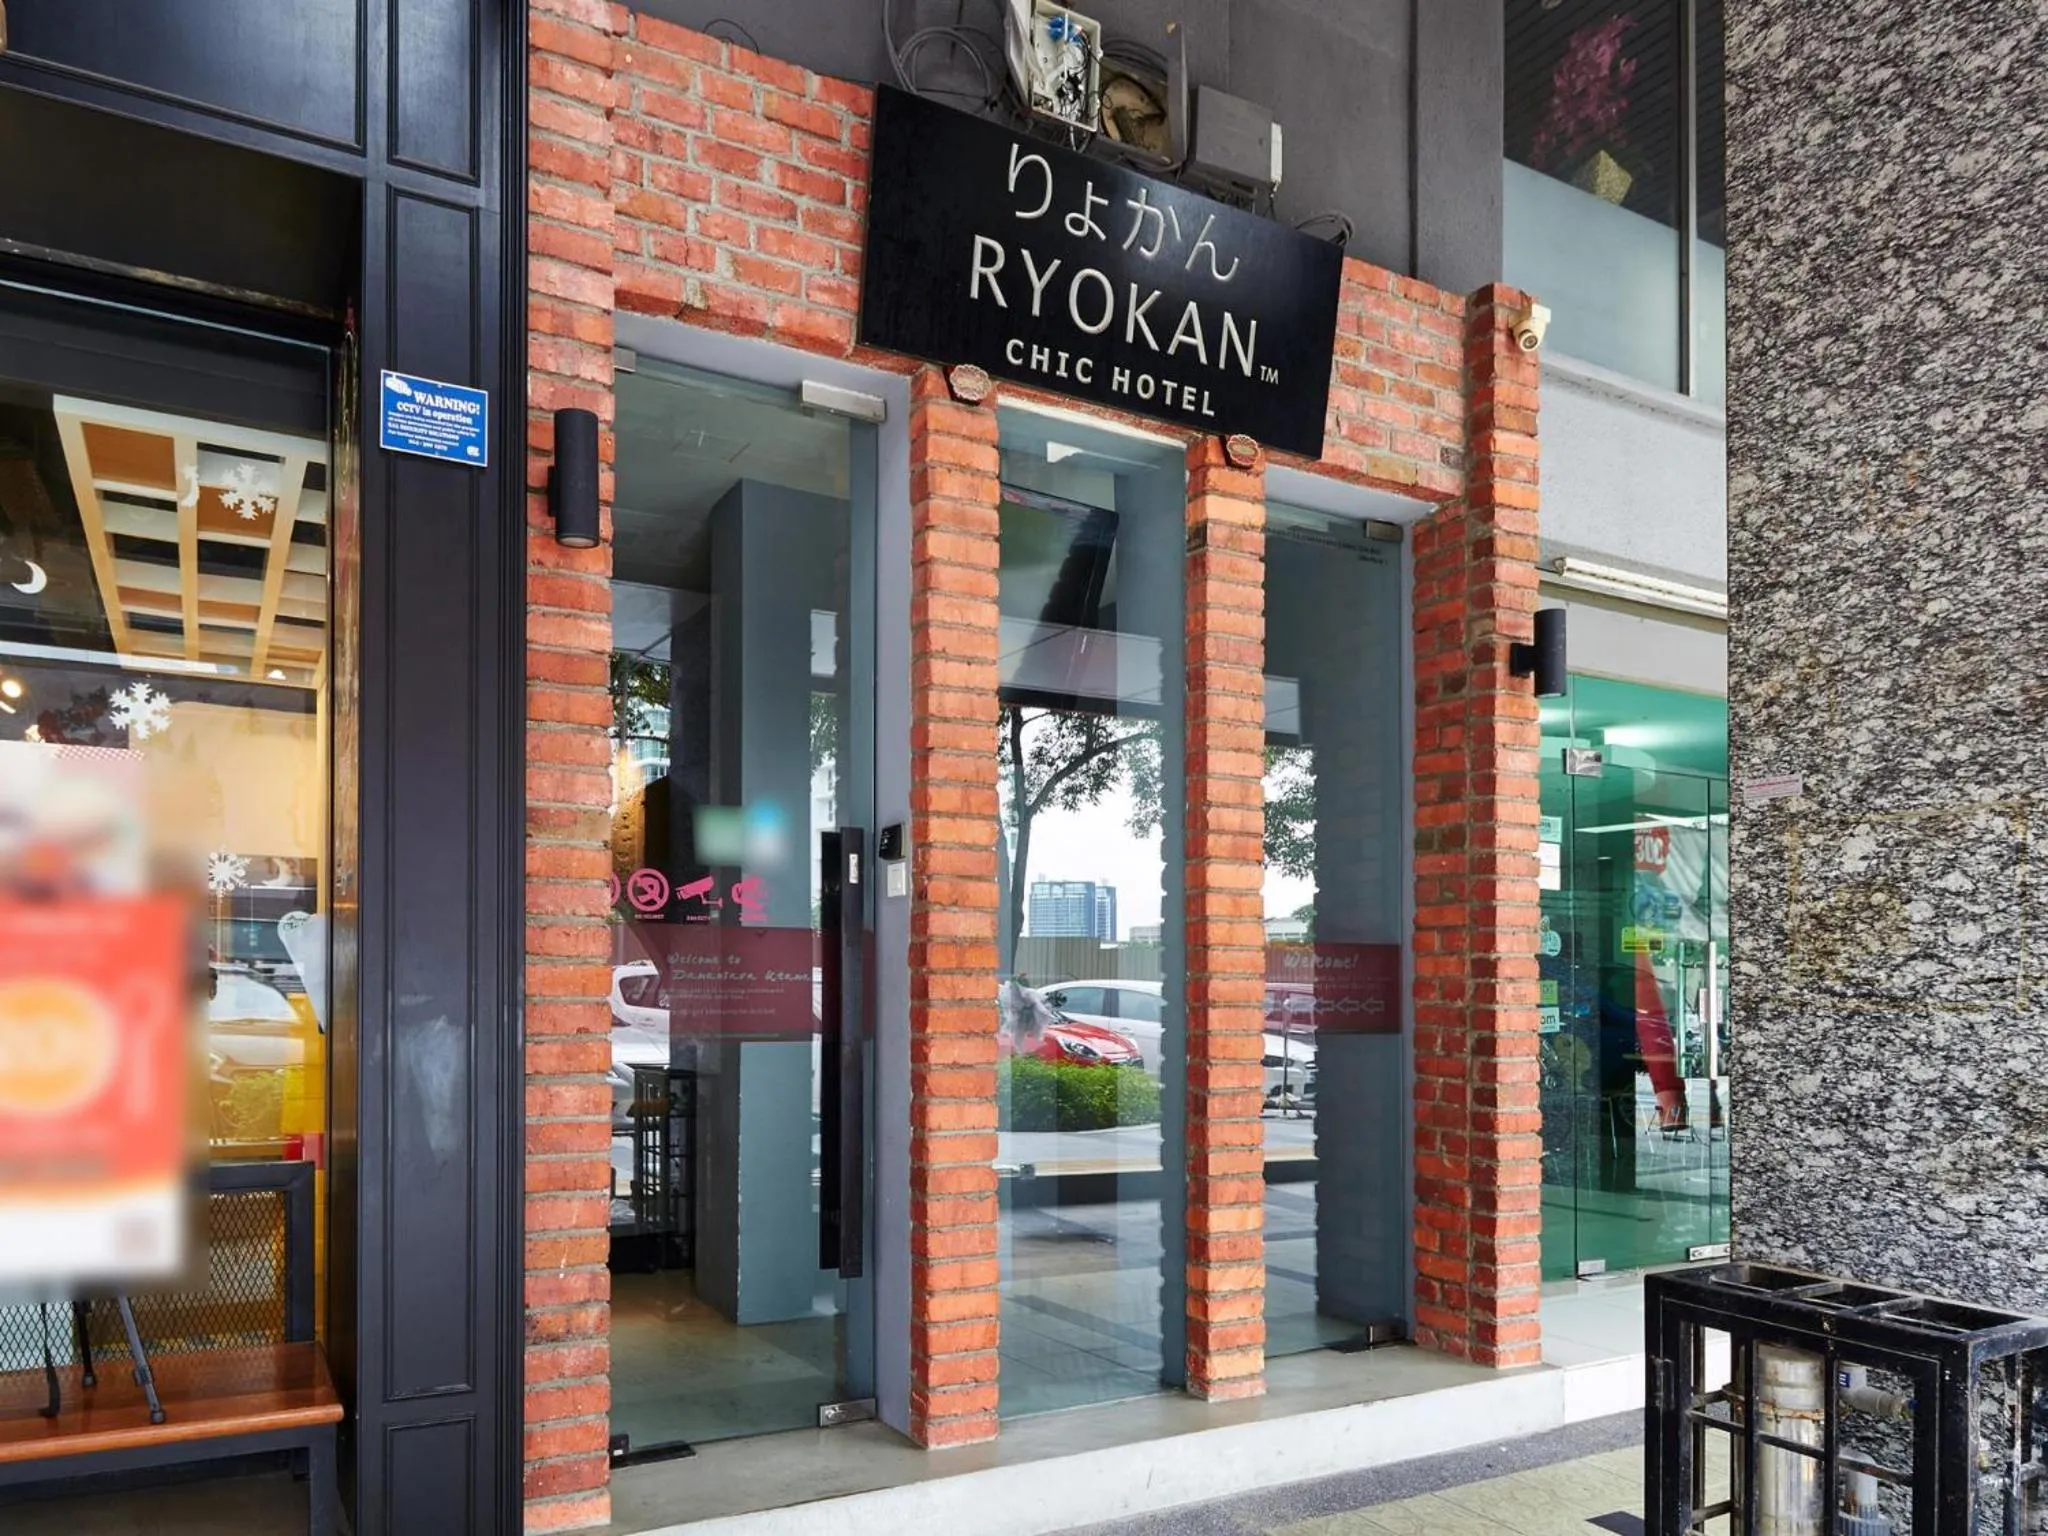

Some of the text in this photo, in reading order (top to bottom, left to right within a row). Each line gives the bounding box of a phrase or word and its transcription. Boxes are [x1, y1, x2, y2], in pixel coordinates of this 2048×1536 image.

[1007, 142, 1241, 282] りょかん
[969, 233, 1258, 378] RYOKAN
[1006, 339, 1215, 418] CHIC HOTEL
[397, 401, 421, 414] CCTV
[422, 406, 432, 417] in
[433, 410, 473, 426] operation
[413, 391, 480, 416] WARNING!
[667, 952, 741, 965] Welcome to
[1284, 953, 1358, 970] Welcome!
